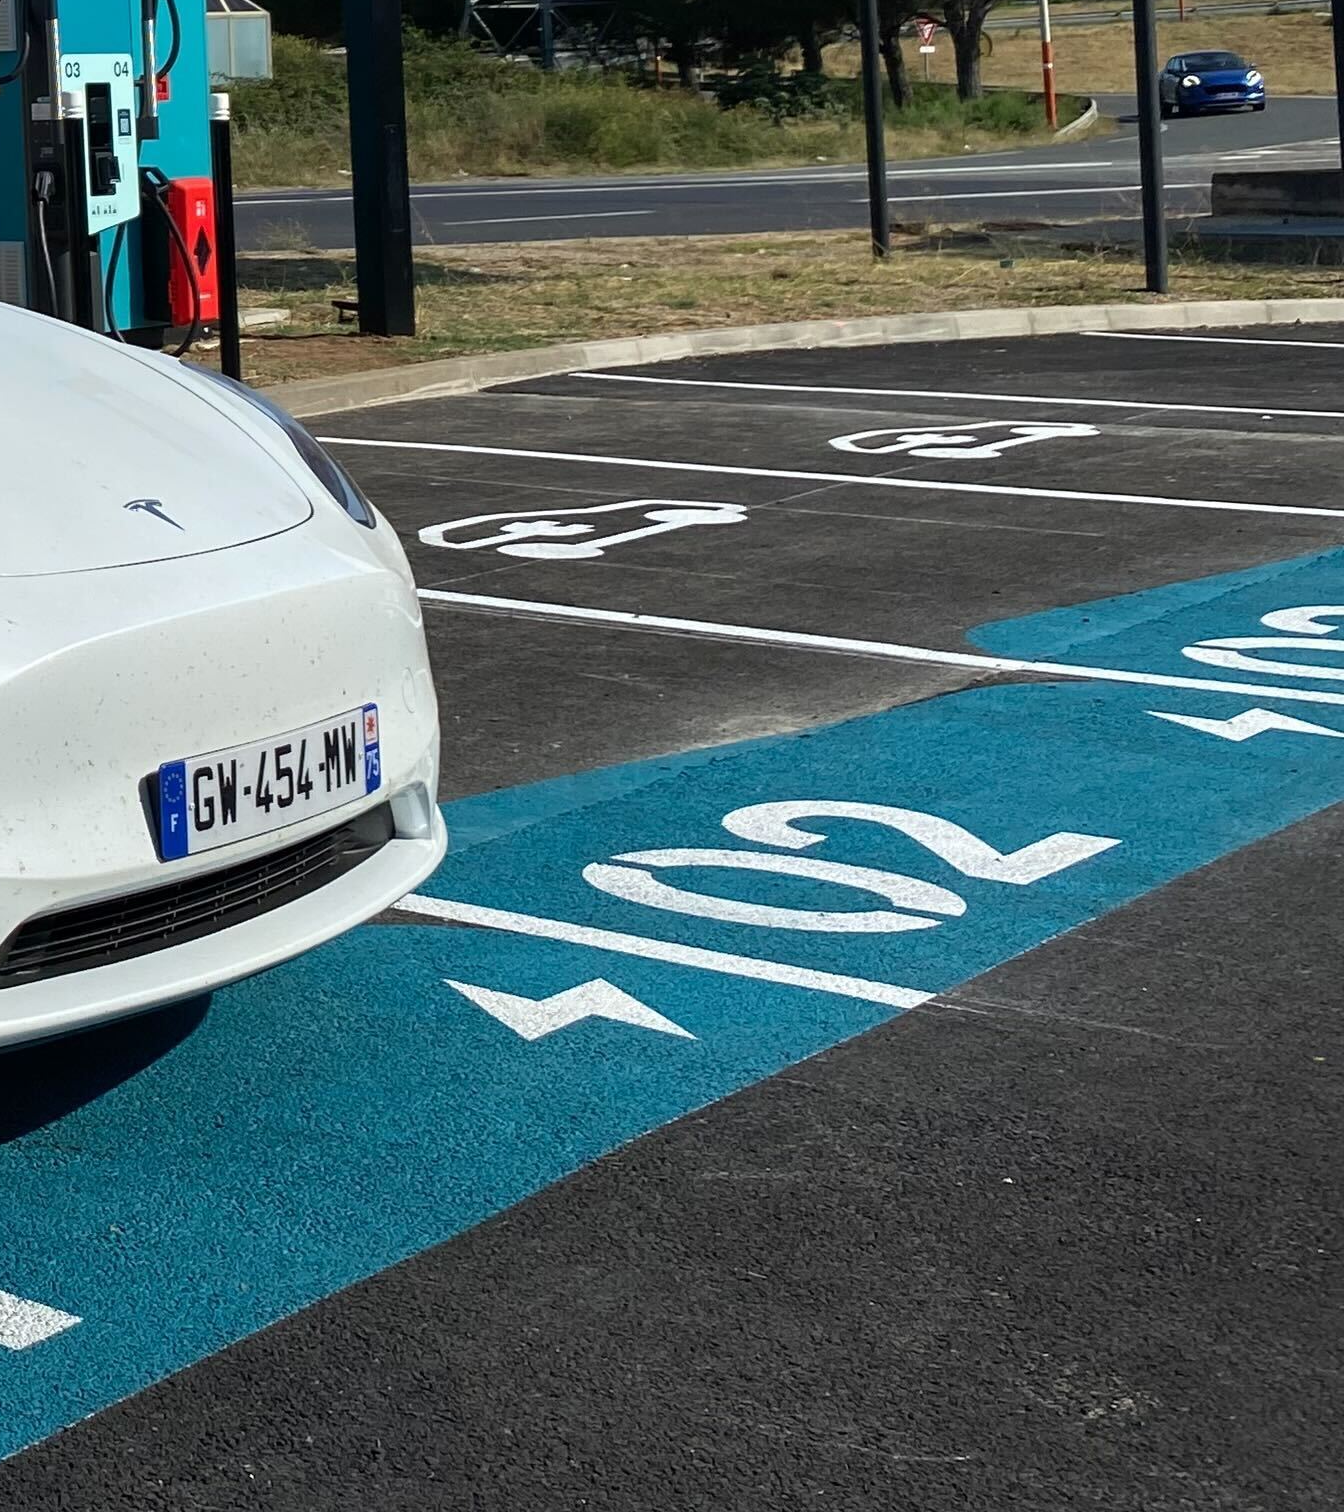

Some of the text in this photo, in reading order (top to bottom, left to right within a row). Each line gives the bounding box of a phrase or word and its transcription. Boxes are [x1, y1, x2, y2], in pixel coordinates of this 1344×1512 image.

[65, 61, 81, 78] 03
[113, 61, 129, 77] 04
[192, 721, 357, 831] GW-454-MW
[365, 748, 380, 781] 75
[170, 813, 179, 833] F
[582, 799, 1121, 934] 02
